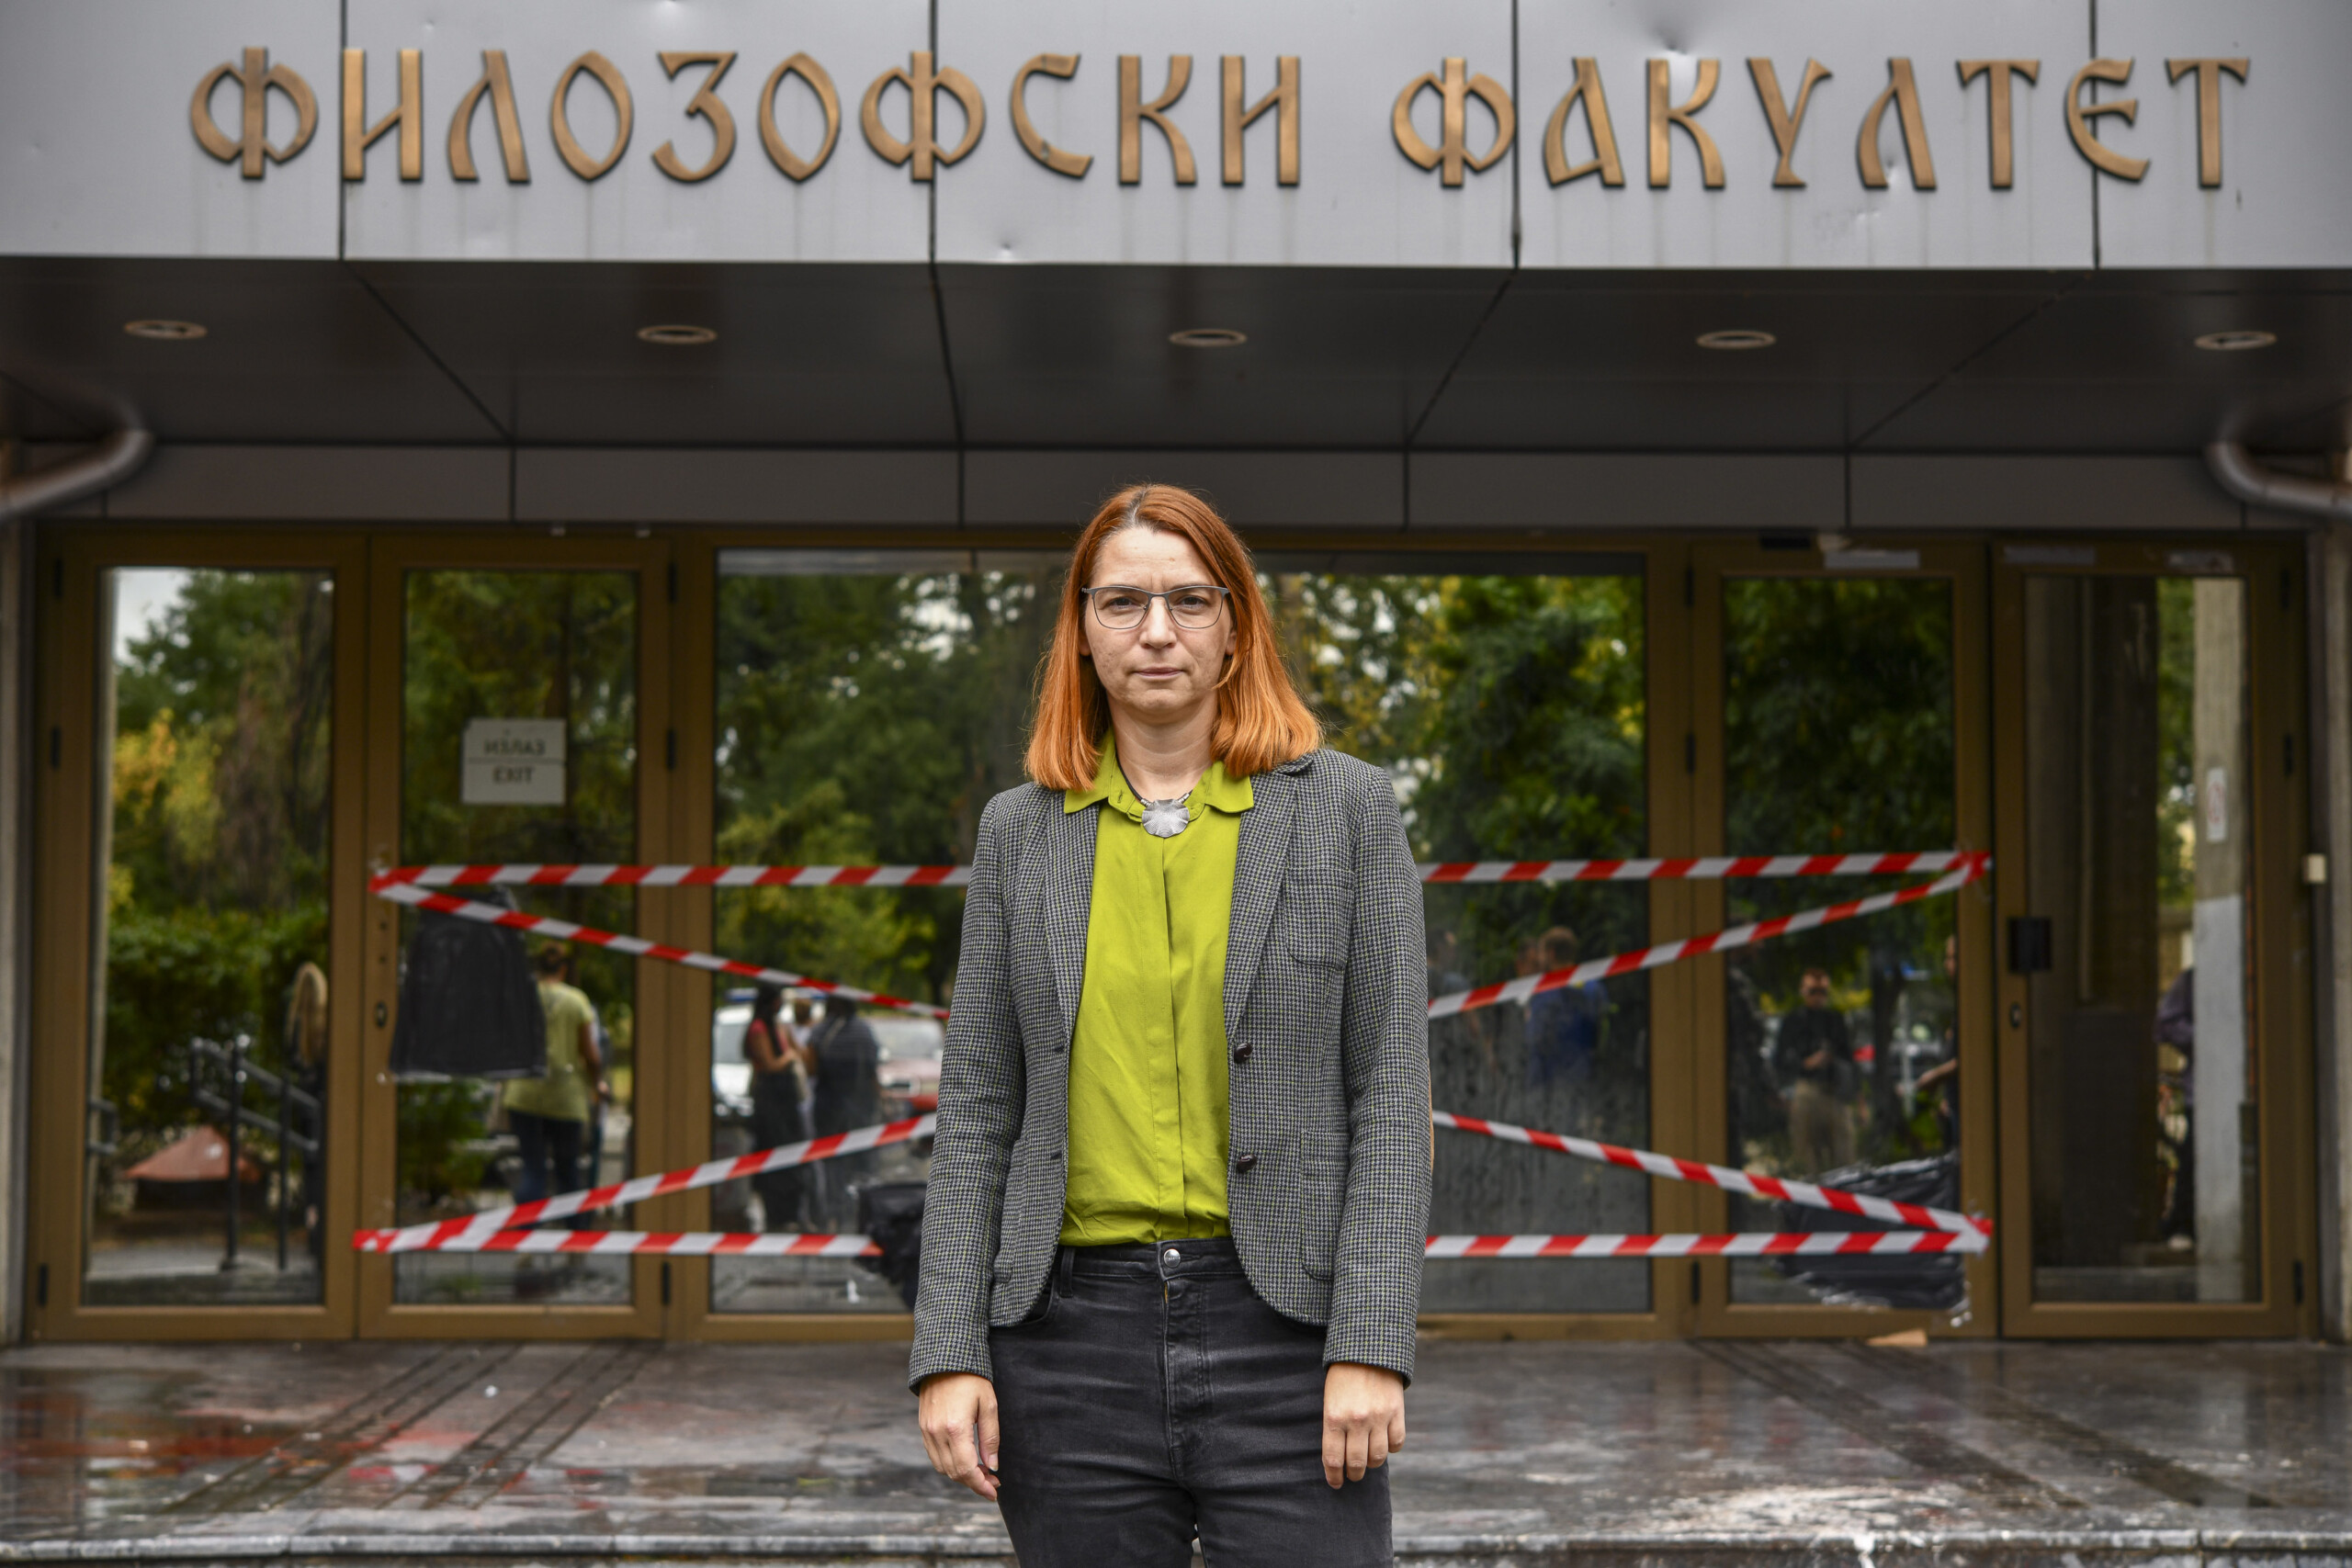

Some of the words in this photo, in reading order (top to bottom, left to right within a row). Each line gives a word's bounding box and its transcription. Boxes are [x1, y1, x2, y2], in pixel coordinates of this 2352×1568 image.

[189, 47, 1301, 186] ФИЛОЗОФСКИ
[1392, 57, 2251, 190] ФАКУЛТЕТ
[493, 765, 535, 784] EXIT
